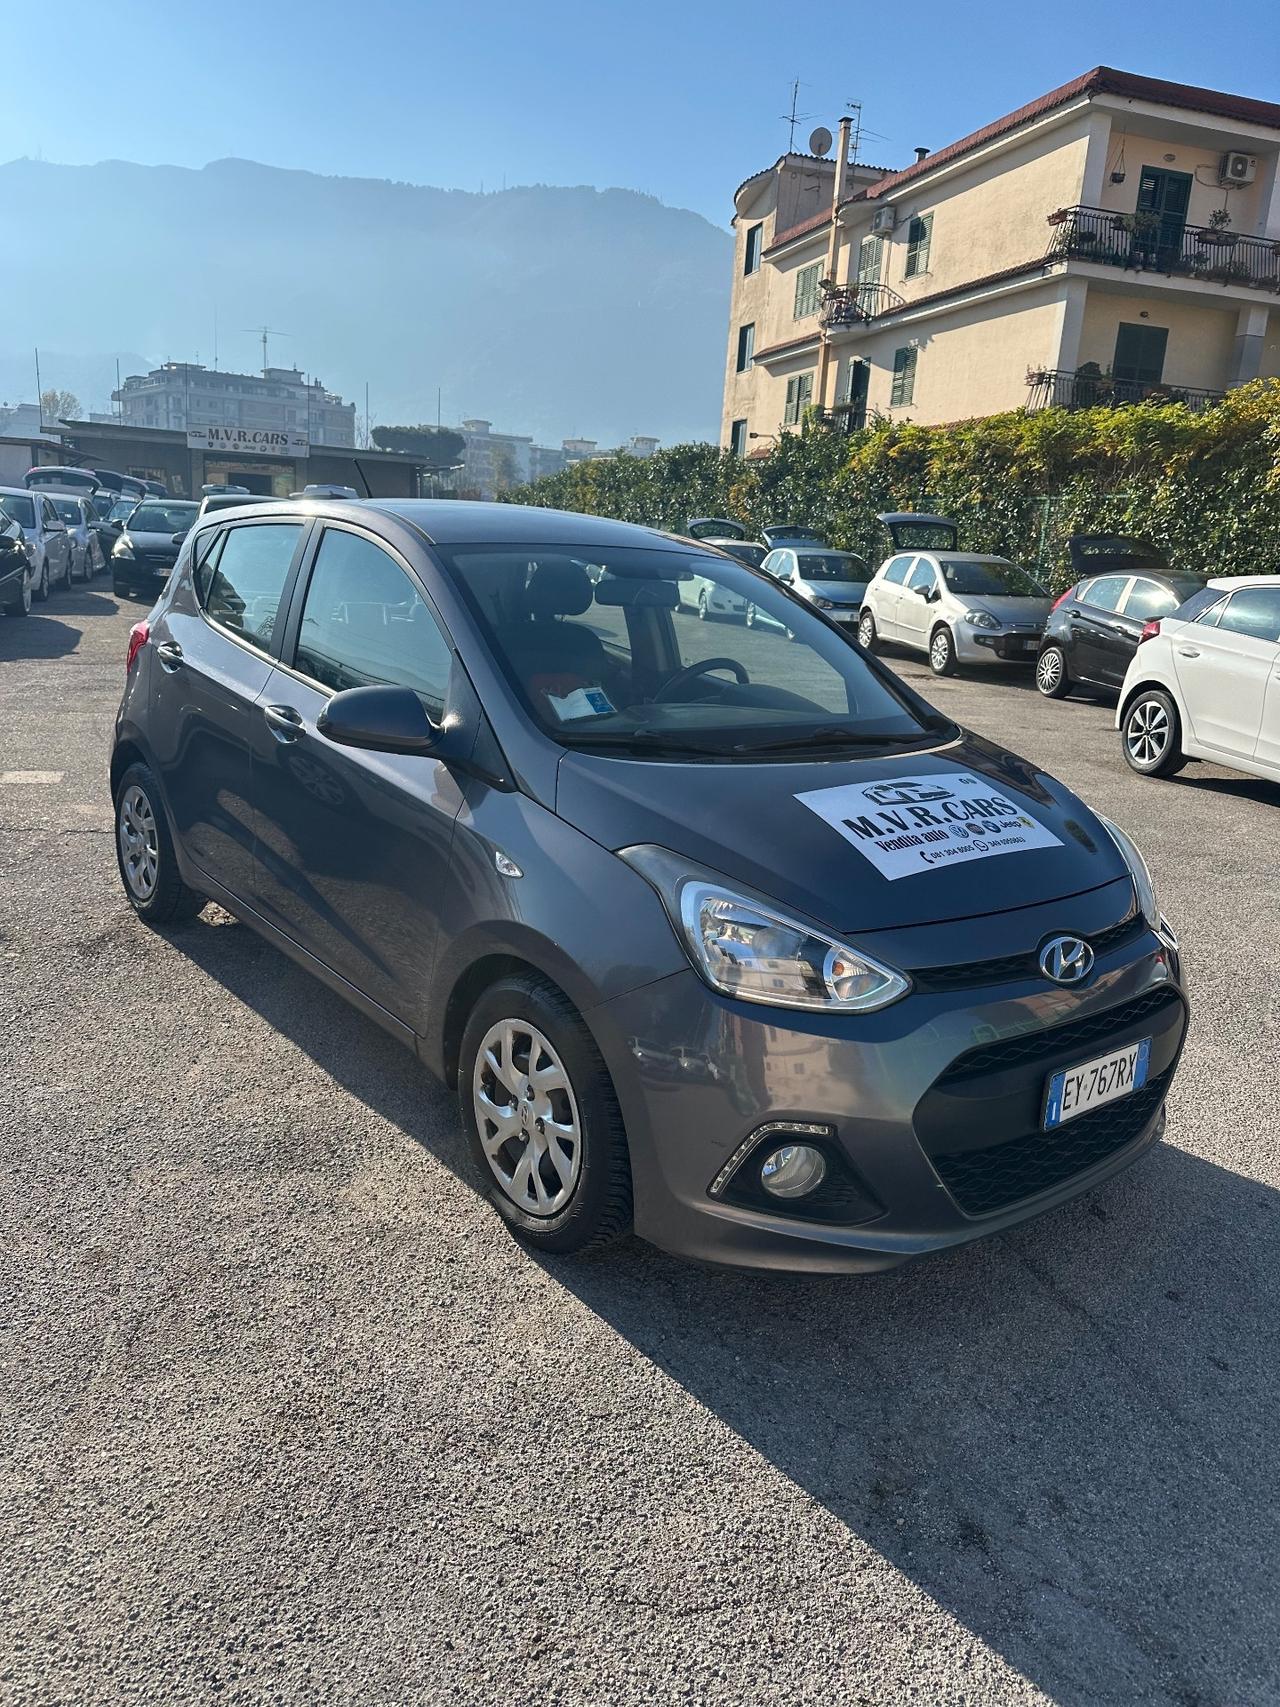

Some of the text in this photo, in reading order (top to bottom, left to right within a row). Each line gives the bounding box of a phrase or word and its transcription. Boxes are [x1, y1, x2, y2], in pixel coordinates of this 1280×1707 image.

[208, 428, 289, 446] M.V.R.CARS
[841, 796, 1018, 840] M.V.R.CARS
[875, 832, 923, 852] Vendita
[922, 829, 950, 844] auto
